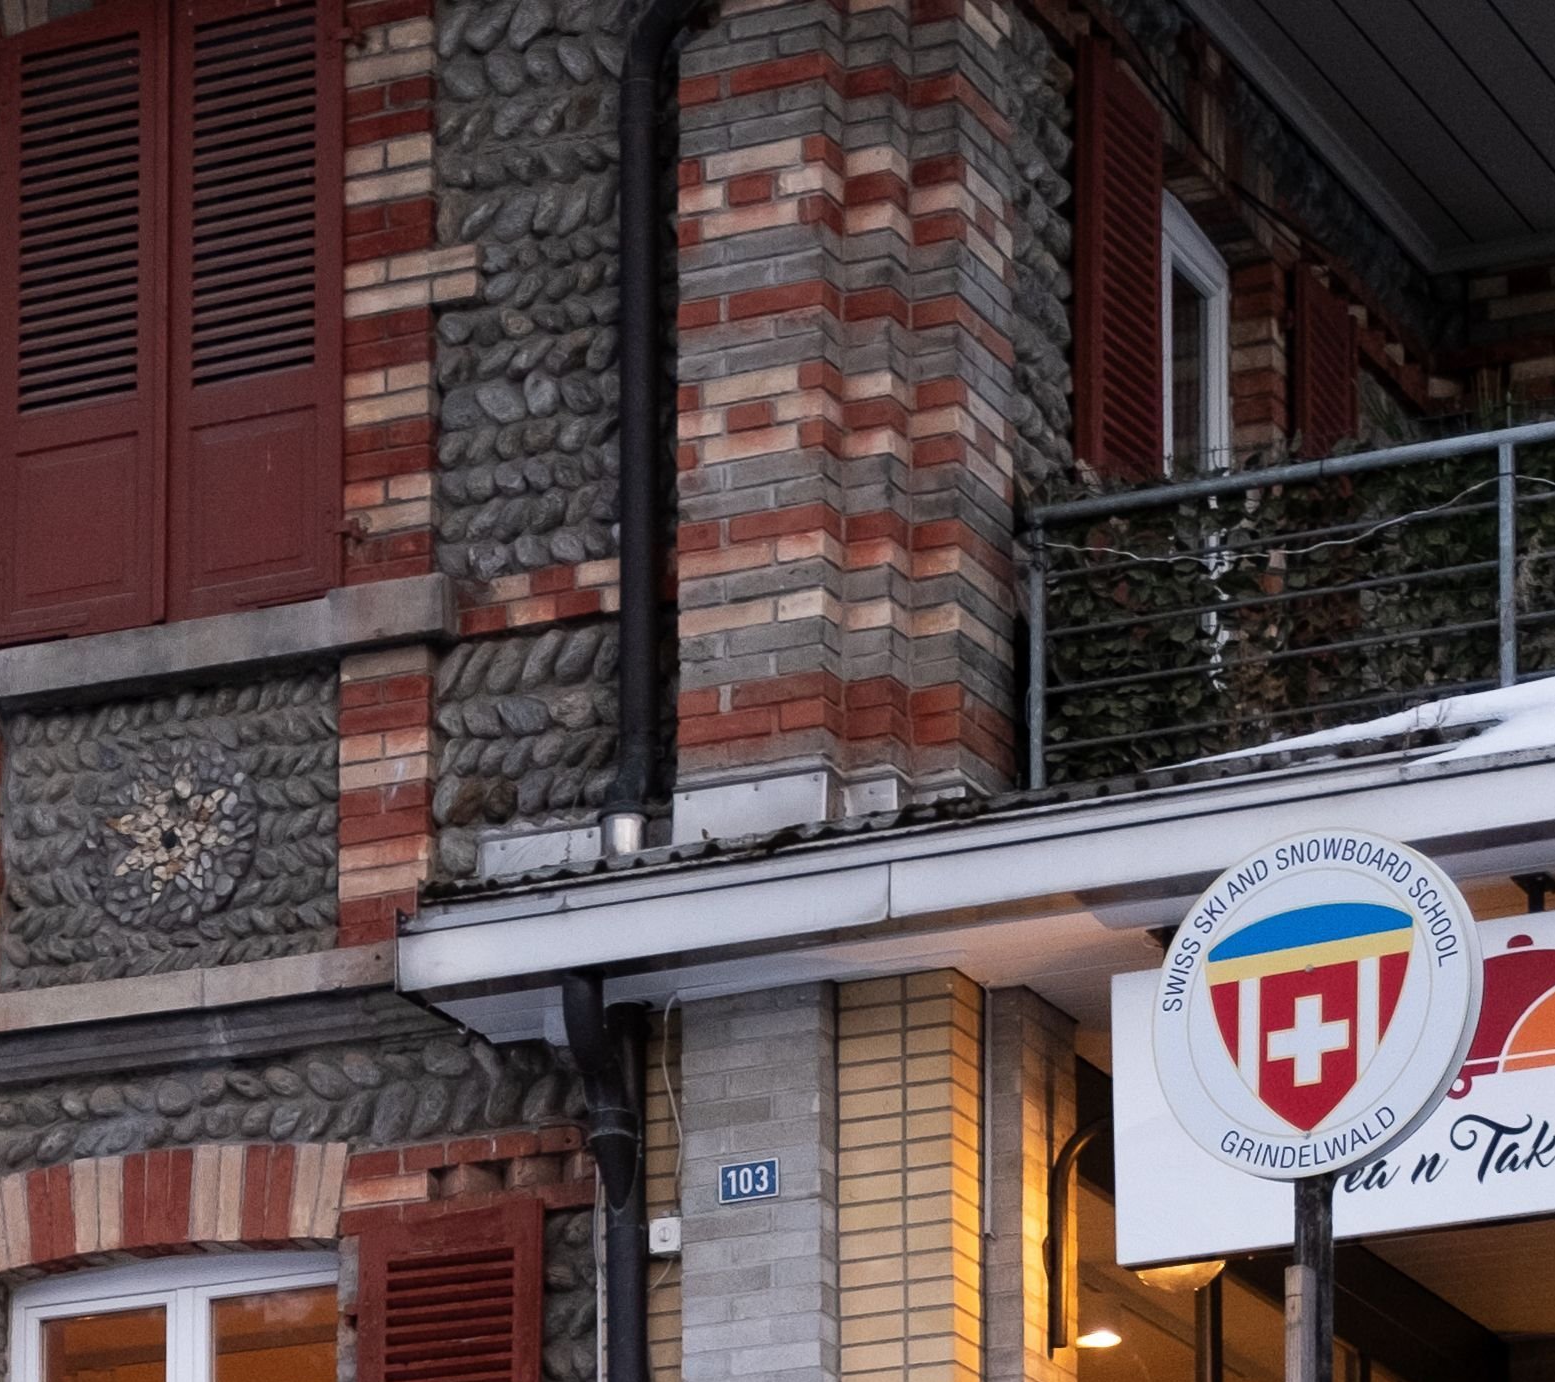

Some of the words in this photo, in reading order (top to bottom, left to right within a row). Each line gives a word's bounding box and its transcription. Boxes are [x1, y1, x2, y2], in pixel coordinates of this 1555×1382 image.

[1162, 937, 1202, 1013] SWISS
[1194, 895, 1228, 934] SKI
[1226, 859, 1269, 900] AND
[1275, 837, 1412, 884] SNOWBOARD
[1408, 876, 1459, 968] SCHOOL
[1220, 1106, 1395, 1169] GRINDELWALD
[726, 1164, 769, 1196] 103
[1342, 1156, 1402, 1194] ea
